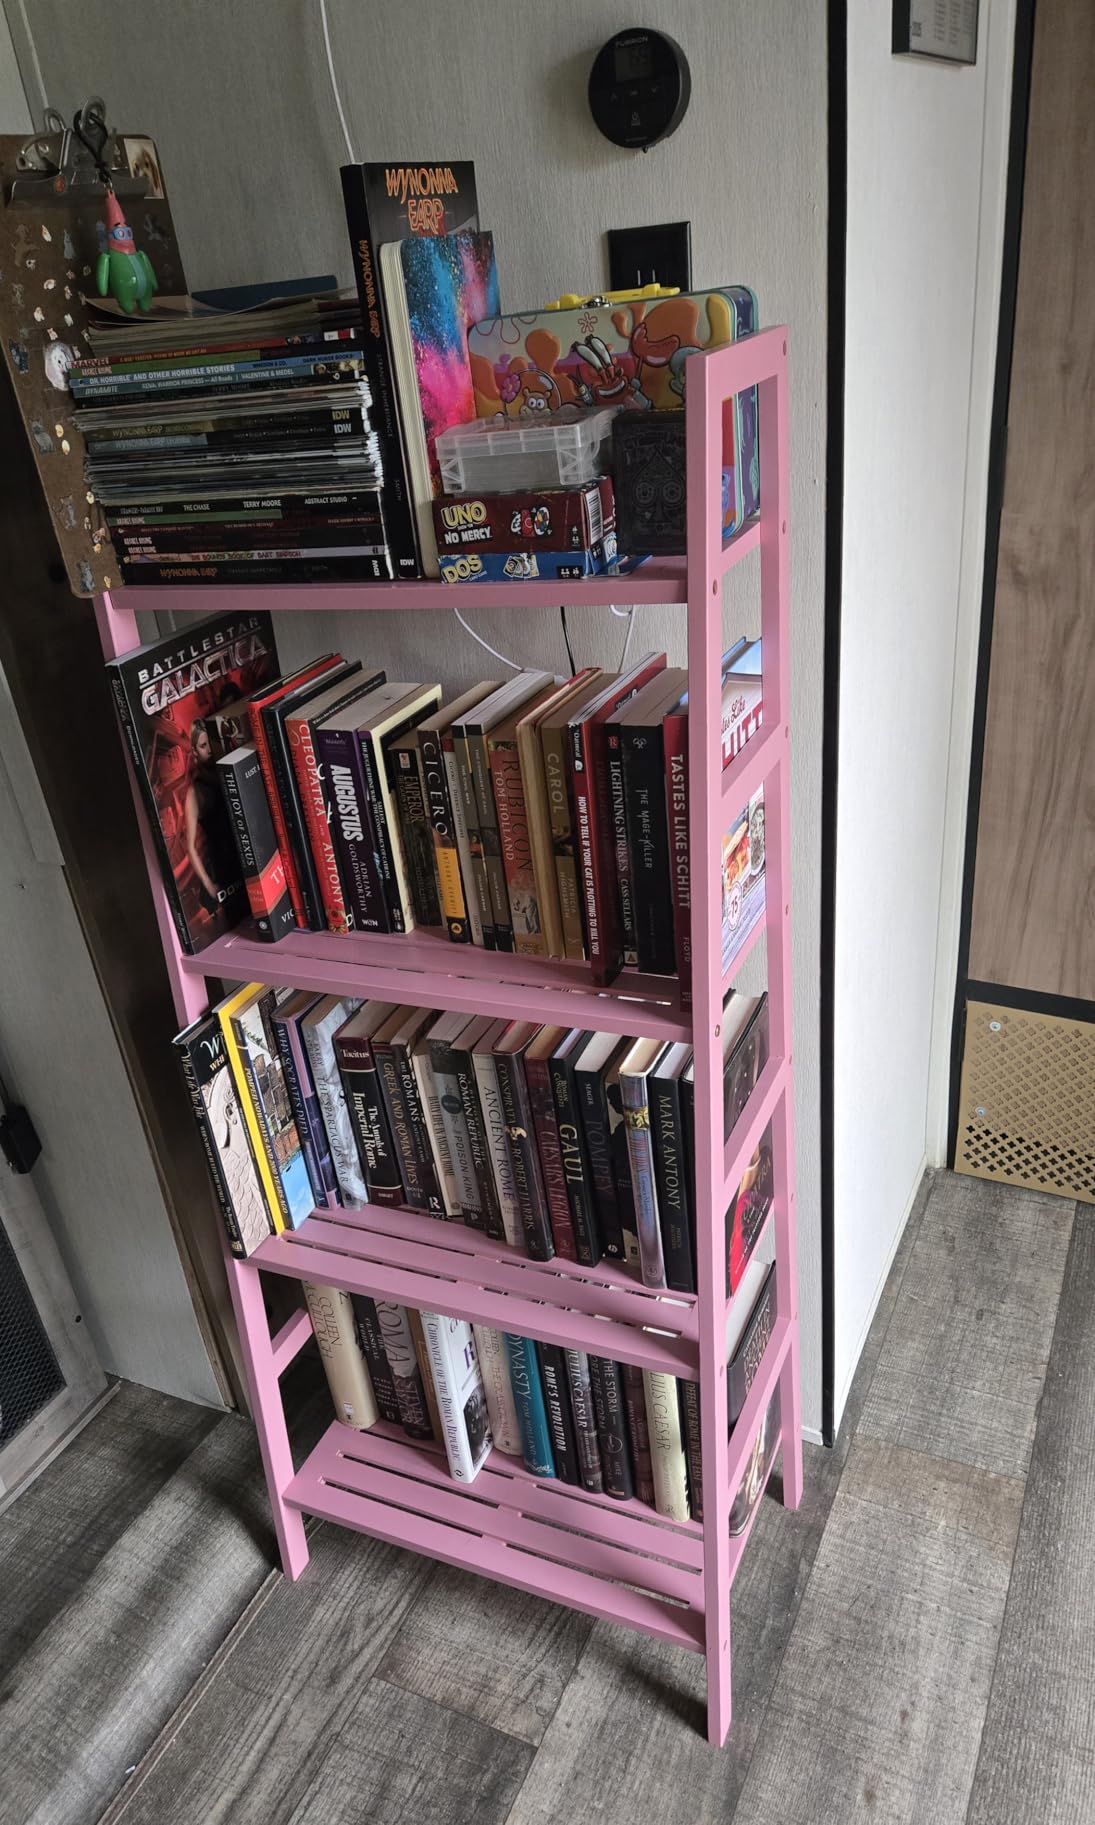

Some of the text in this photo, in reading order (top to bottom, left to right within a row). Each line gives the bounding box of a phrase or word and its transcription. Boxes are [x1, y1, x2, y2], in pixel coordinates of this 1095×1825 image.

[386, 168, 458, 204] WYNONNA
[408, 198, 444, 234] EARP
[359, 240, 381, 338] WYNONNA EARP
[71, 357, 110, 368] MARVEL
[100, 375, 130, 384] HORRIBLE
[149, 371, 170, 379] OTHER
[172, 368, 205, 377] HORRIBLE
[207, 365, 234, 374] STORIES
[276, 368, 294, 376] MEDEL
[85, 386, 118, 395] DYNAMITE
[332, 410, 350, 420] IDW
[334, 424, 351, 433] IDW
[441, 501, 487, 529] UNO
[445, 527, 491, 544] NO MERCY
[160, 568, 200, 581] WYNONNA
[201, 568, 218, 577] EARP
[372, 560, 380, 576] IDW
[443, 554, 482, 583] DOS
[138, 616, 259, 684] BATTLESTAR
[141, 635, 268, 715] GALACTICA
[330, 764, 364, 842] AUGUSTUS
[404, 776, 424, 823] EMPEROR
[423, 742, 448, 835] CICERO
[548, 753, 563, 814] CAROL
[578, 796, 588, 812] HOW
[610, 761, 626, 824] LIGHTNING
[225, 772, 255, 866] THE JOY SEXUS
[299, 724, 326, 817] CLEOPATRA
[322, 842, 343, 905] ANTONY
[494, 771, 514, 860] TOM HOLLAND
[502, 760, 533, 870] RUBICON
[580, 814, 589, 824] TO
[581, 826, 590, 839] TELL
[635, 789, 655, 869] THE MAGE-KILLER
[671, 755, 690, 908] TASTES LIKE SCHITT
[374, 814, 385, 846] CONSPIRACY
[381, 853, 390, 879] CATILINE
[583, 848, 592, 865] YOUR
[615, 827, 628, 872] STRIKES
[348, 844, 367, 912] GOLDSWORTHY
[360, 862, 372, 898] ADRIAN
[560, 871, 570, 918] HIGHSMITH
[584, 866, 593, 878] CAT
[567, 878, 577, 914] PATRICIA
[586, 887, 597, 916] PLOTTING
[620, 878, 632, 931] CASS SELLARS
[589, 918, 598, 926] TO
[590, 928, 599, 940] KILL
[591, 942, 600, 954] YOU
[683, 936, 691, 962] FLOYD
[342, 1049, 370, 1059] Tacitus
[180, 1052, 204, 1119] What Life Was Like
[276, 1027, 309, 1135] WHY SOCRATES DIED
[402, 1073, 420, 1121] ROMANS
[499, 1063, 516, 1127] CONSPIRATA
[554, 1072, 564, 1108] CONQUESTS
[560, 1080, 568, 1103] ROMAN
[584, 1083, 593, 1105] SEAGER
[383, 1062, 418, 1184] GREEK AND ROMAN LIVES
[427, 1096, 440, 1112] DAILY
[431, 1113, 443, 1126] LIFE
[458, 1072, 482, 1169] ROMAN REPUBLIC
[658, 1096, 675, 1140] MARK
[246, 1067, 288, 1214] POMPEII NOWADAYS AND YEARS AGO
[318, 1077, 348, 1183] THE SPARTACUS WAR
[352, 1092, 376, 1168] Imperial Rome
[367, 1106, 386, 1158] The Annals of
[437, 1135, 450, 1158] ANCIENT
[484, 1087, 506, 1151] ANCIENT
[497, 1158, 513, 1198] ROME
[205, 1141, 213, 1156] ROME
[216, 1184, 225, 1201] WORLD
[442, 1159, 454, 1176] ROME
[456, 1134, 473, 1200] POISON KING
[560, 1124, 584, 1184] GAUL
[585, 1119, 614, 1198] POMPEY
[513, 1147, 536, 1230] ROBERT HARRIS
[663, 1145, 680, 1210] ANTONY
[551, 1185, 572, 1228] LEGION
[321, 1297, 343, 1346] COLLEEN
[359, 1323, 370, 1351] WORLD
[365, 1317, 380, 1360] CLASSICAL
[376, 1302, 410, 1364] ROMA
[510, 1335, 532, 1401] DYNASTY
[568, 1350, 583, 1387] JULIUS
[603, 1360, 618, 1413] THE STORM
[650, 1373, 666, 1401] LIUS
[396, 1379, 413, 1423] SAYLOR
[406, 1381, 424, 1426] STEVEN
[428, 1322, 442, 1369] CHRONICLE
[437, 1370, 444, 1380] OF
[443, 1398, 453, 1424] ROMAN
[448, 1424, 460, 1462] REPUBLIC
[544, 1365, 568, 1451] ROME'S REVOLUTION
[574, 1388, 588, 1428] CAESAR
[686, 1384, 696, 1408] DEFEAT
[654, 1403, 672, 1450] CAESAR
[689, 1420, 699, 1436] ROME
